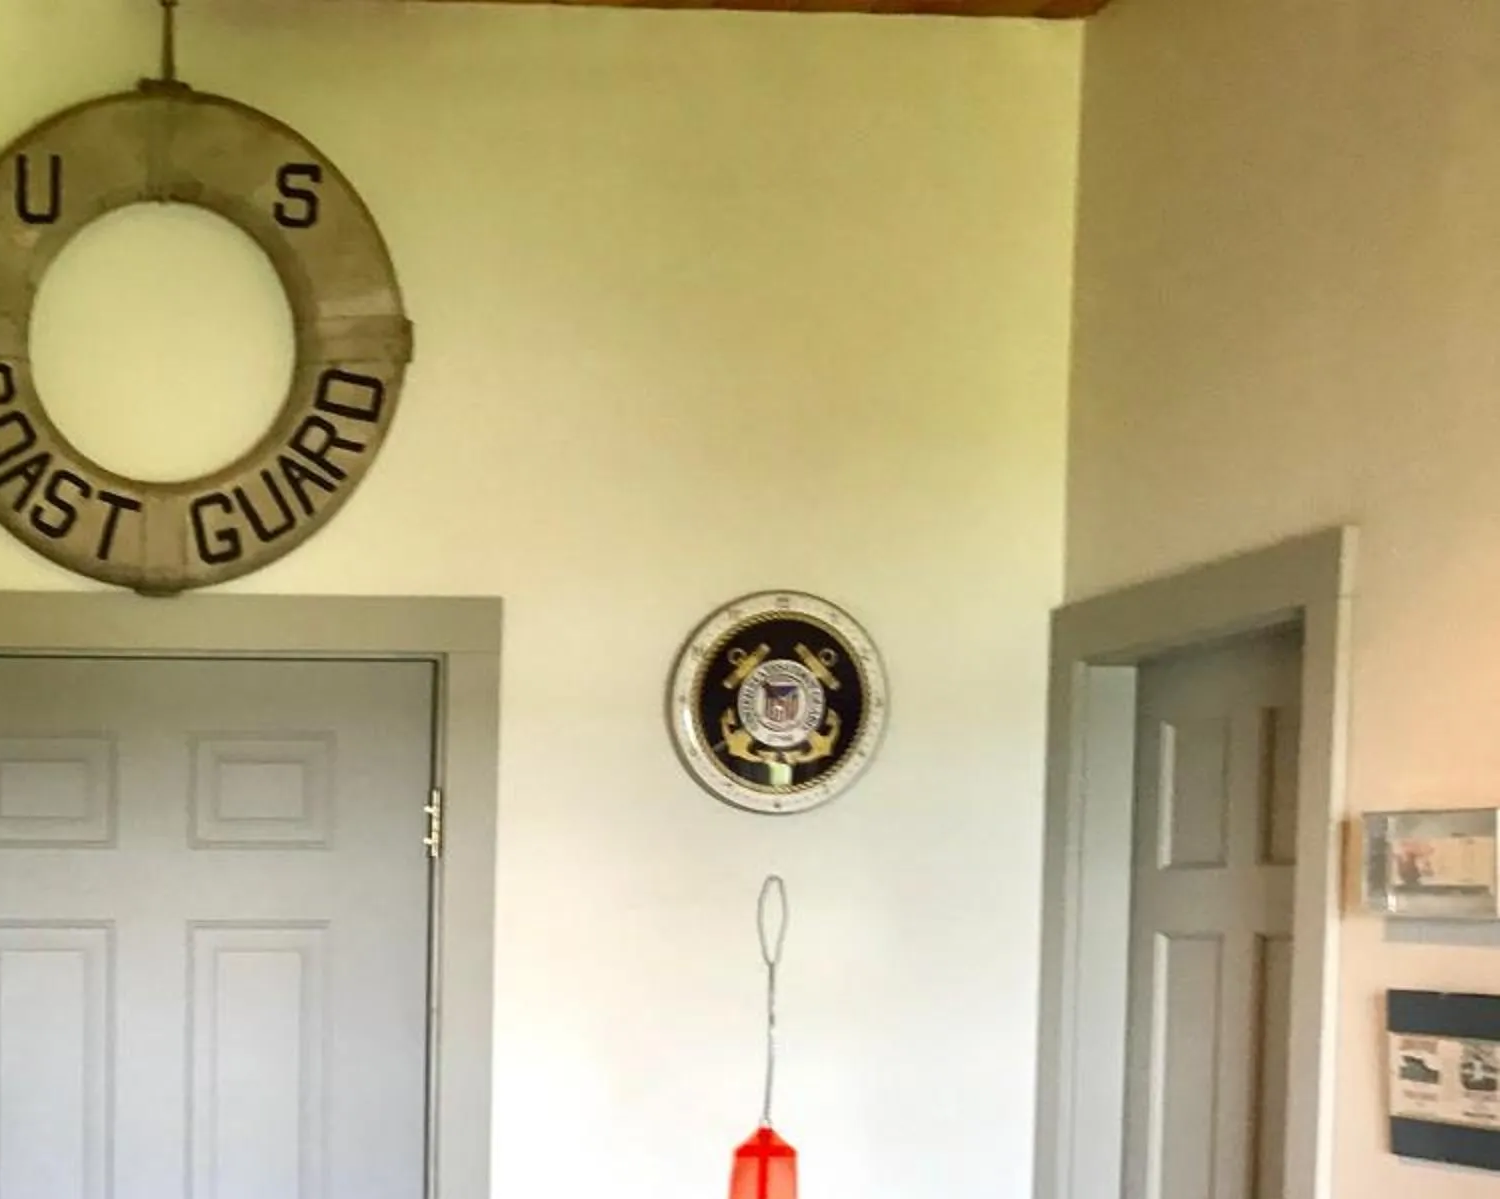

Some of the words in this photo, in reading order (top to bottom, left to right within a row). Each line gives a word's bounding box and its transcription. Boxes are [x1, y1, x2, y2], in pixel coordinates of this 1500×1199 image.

[14, 154, 61, 224] U
[273, 162, 323, 229] S
[190, 368, 385, 565] GUARD
